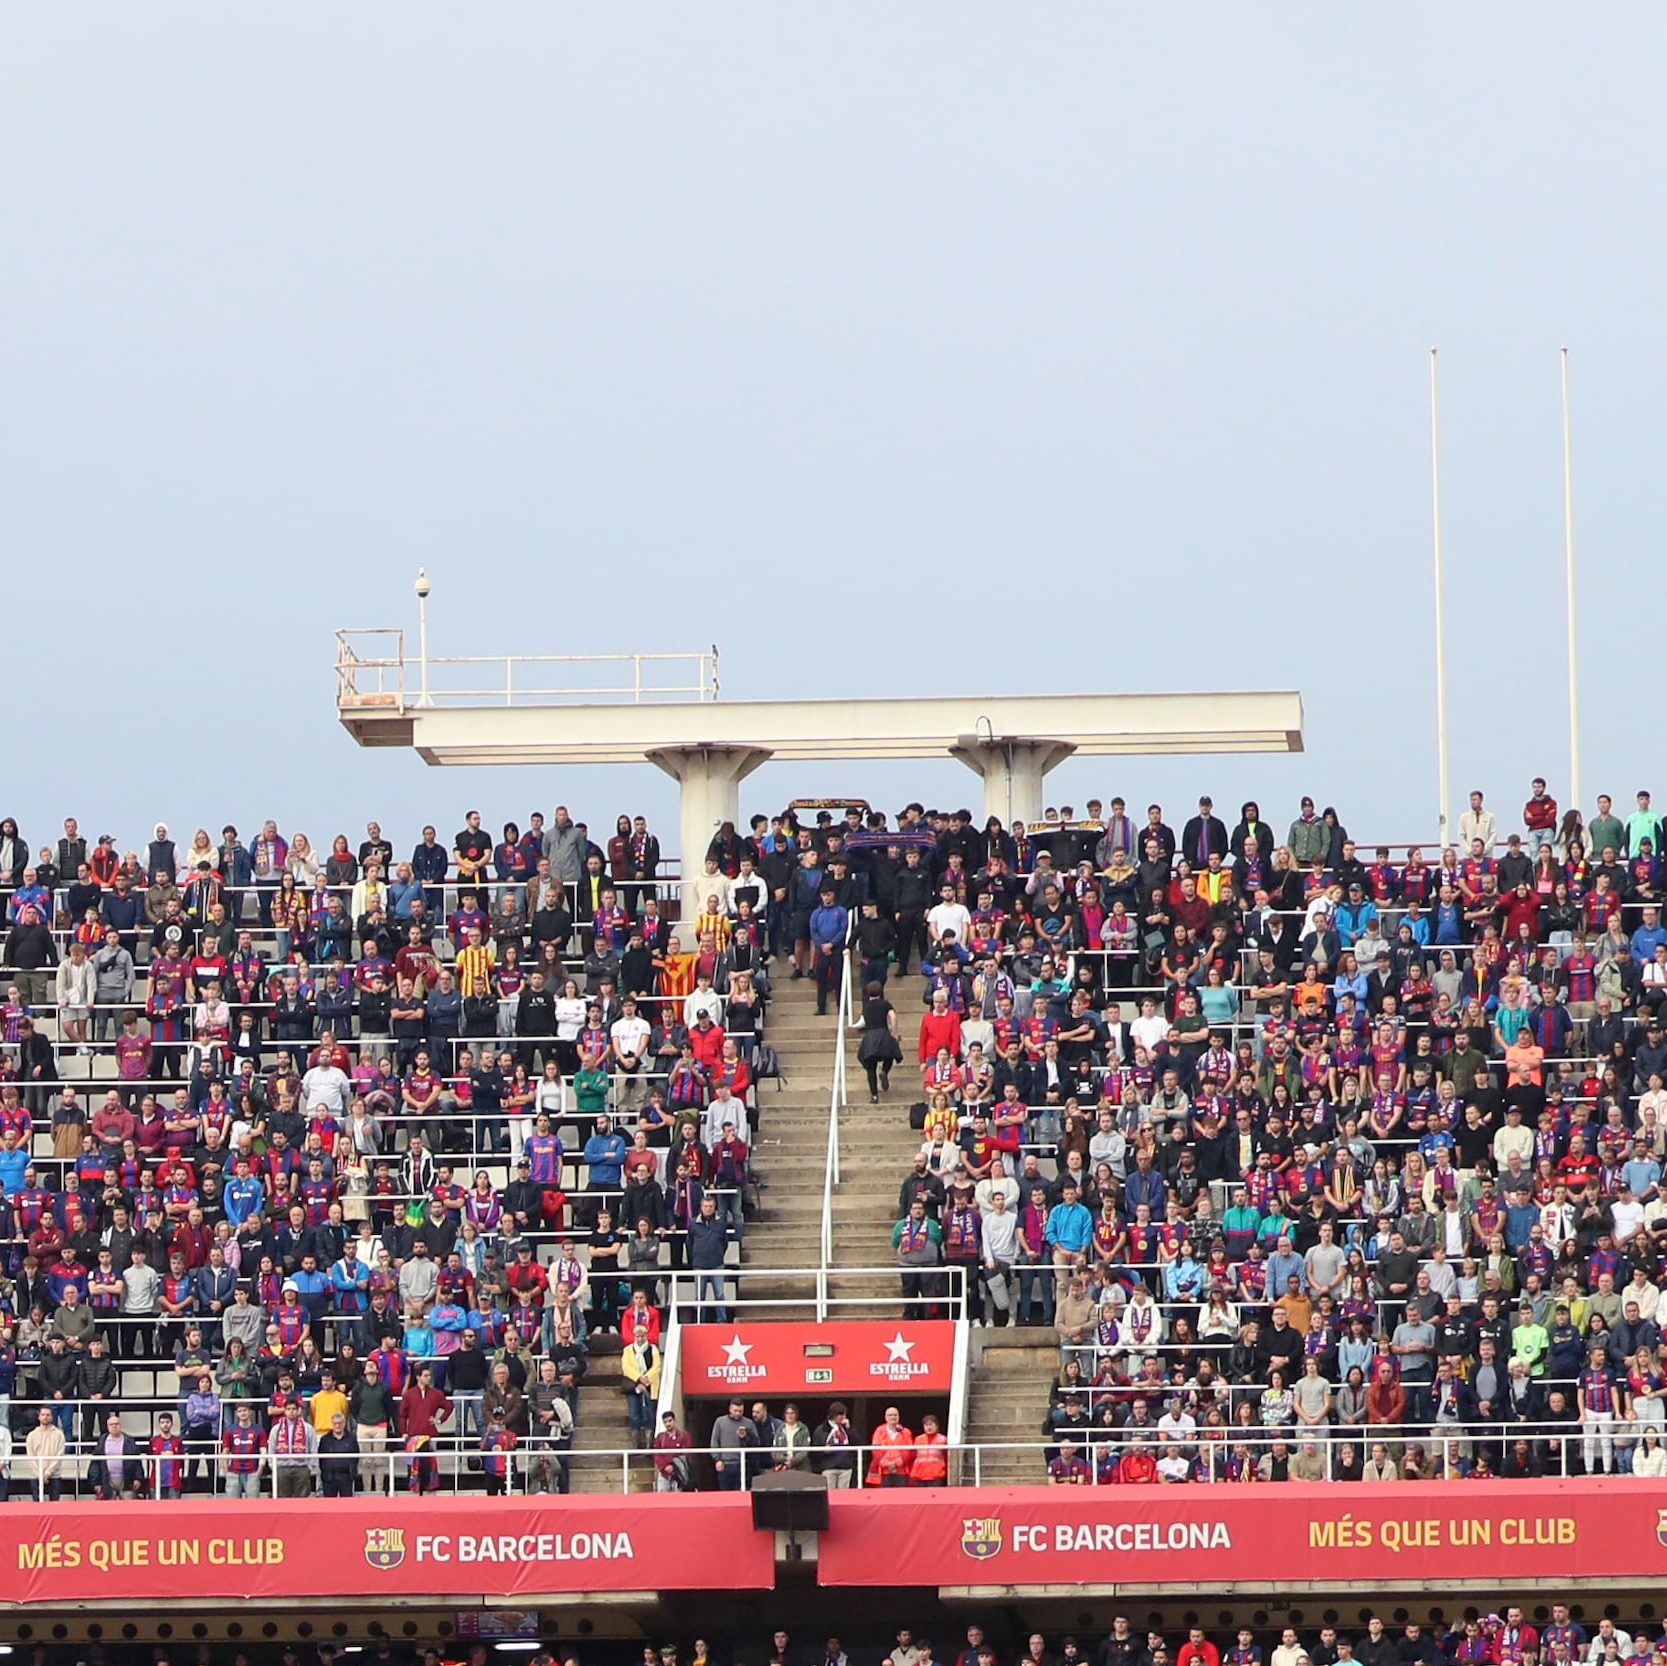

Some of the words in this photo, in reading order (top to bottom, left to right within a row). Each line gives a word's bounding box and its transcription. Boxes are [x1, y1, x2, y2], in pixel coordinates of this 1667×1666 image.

[708, 1365, 766, 1377] ESTRELLA
[870, 1362, 929, 1375] ESTRELLA
[417, 1535, 450, 1562] FC
[458, 1533, 634, 1562] BARCELONA
[1013, 1525, 1047, 1552] FC
[1055, 1523, 1231, 1551] BARCELONA
[1309, 1514, 1373, 1548] MÉS
[1380, 1520, 1441, 1553] QUE
[1449, 1519, 1491, 1546] UN
[1499, 1518, 1576, 1545] CLUB
[18, 1535, 81, 1570] MÉS
[88, 1540, 150, 1572] QUE
[157, 1539, 200, 1566] UN
[207, 1538, 284, 1565] CLUB
